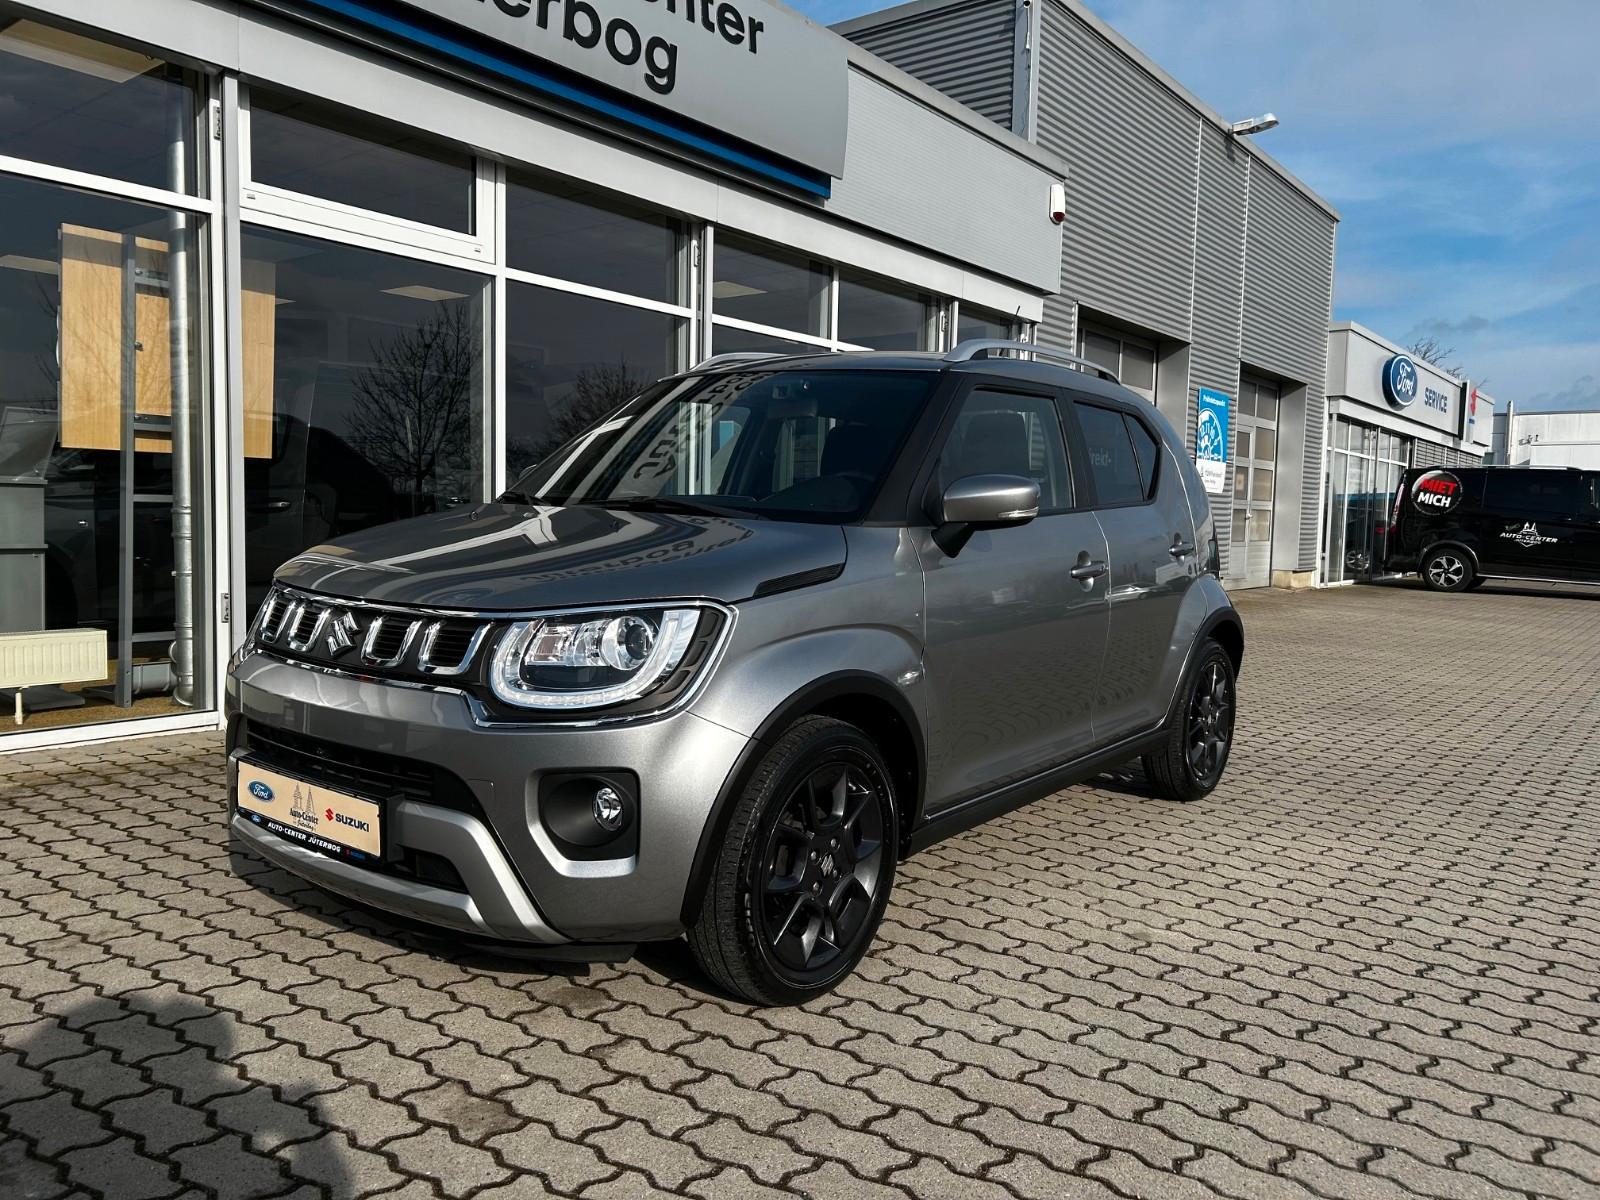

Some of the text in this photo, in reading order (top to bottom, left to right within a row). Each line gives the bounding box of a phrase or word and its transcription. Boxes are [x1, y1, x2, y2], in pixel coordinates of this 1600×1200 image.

[1424, 387, 1448, 413] SERVICE
[1419, 479, 1457, 496] MIET
[1417, 491, 1452, 508] MICH
[267, 822, 307, 841] AUTO-CENTER
[335, 813, 370, 832] SUZUKI
